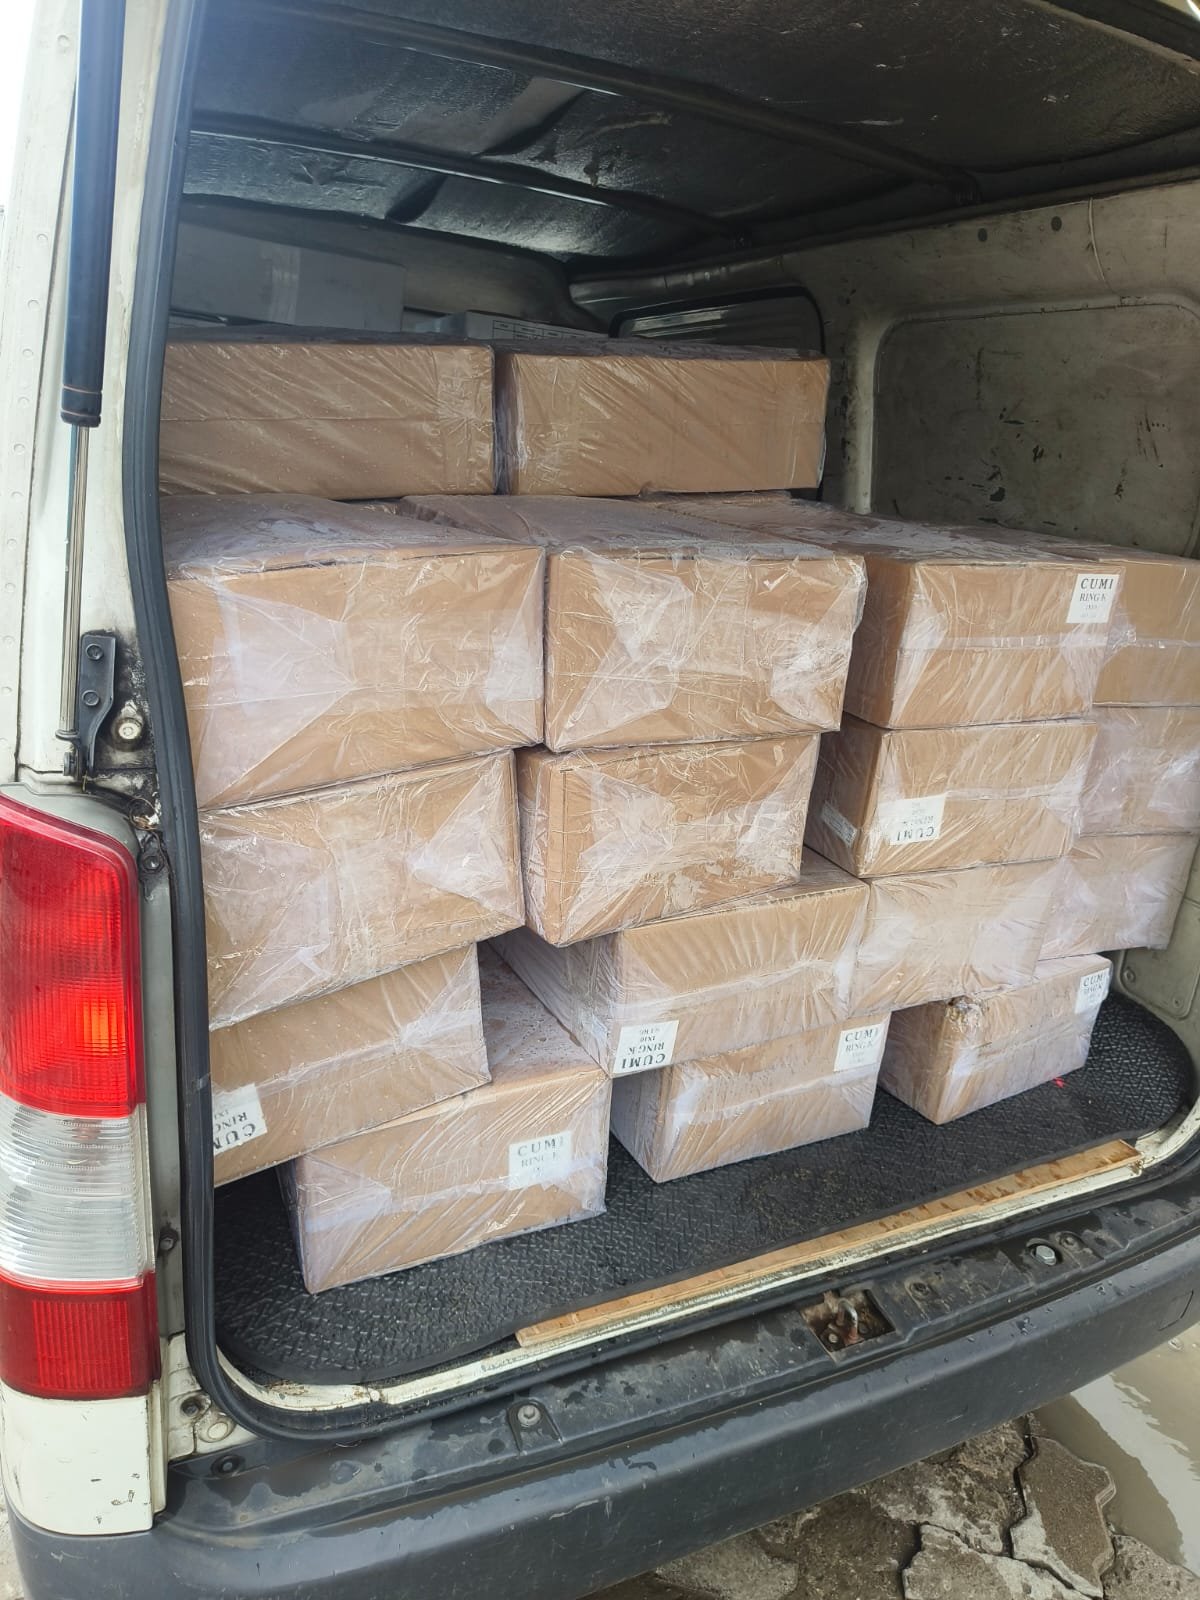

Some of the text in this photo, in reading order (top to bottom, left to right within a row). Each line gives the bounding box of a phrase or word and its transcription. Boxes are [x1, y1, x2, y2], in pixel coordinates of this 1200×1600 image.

[1080, 577, 1114, 590] CUMI
[896, 825, 935, 842] CUMI
[637, 1041, 665, 1053] RING
[621, 1053, 666, 1069] CUMI
